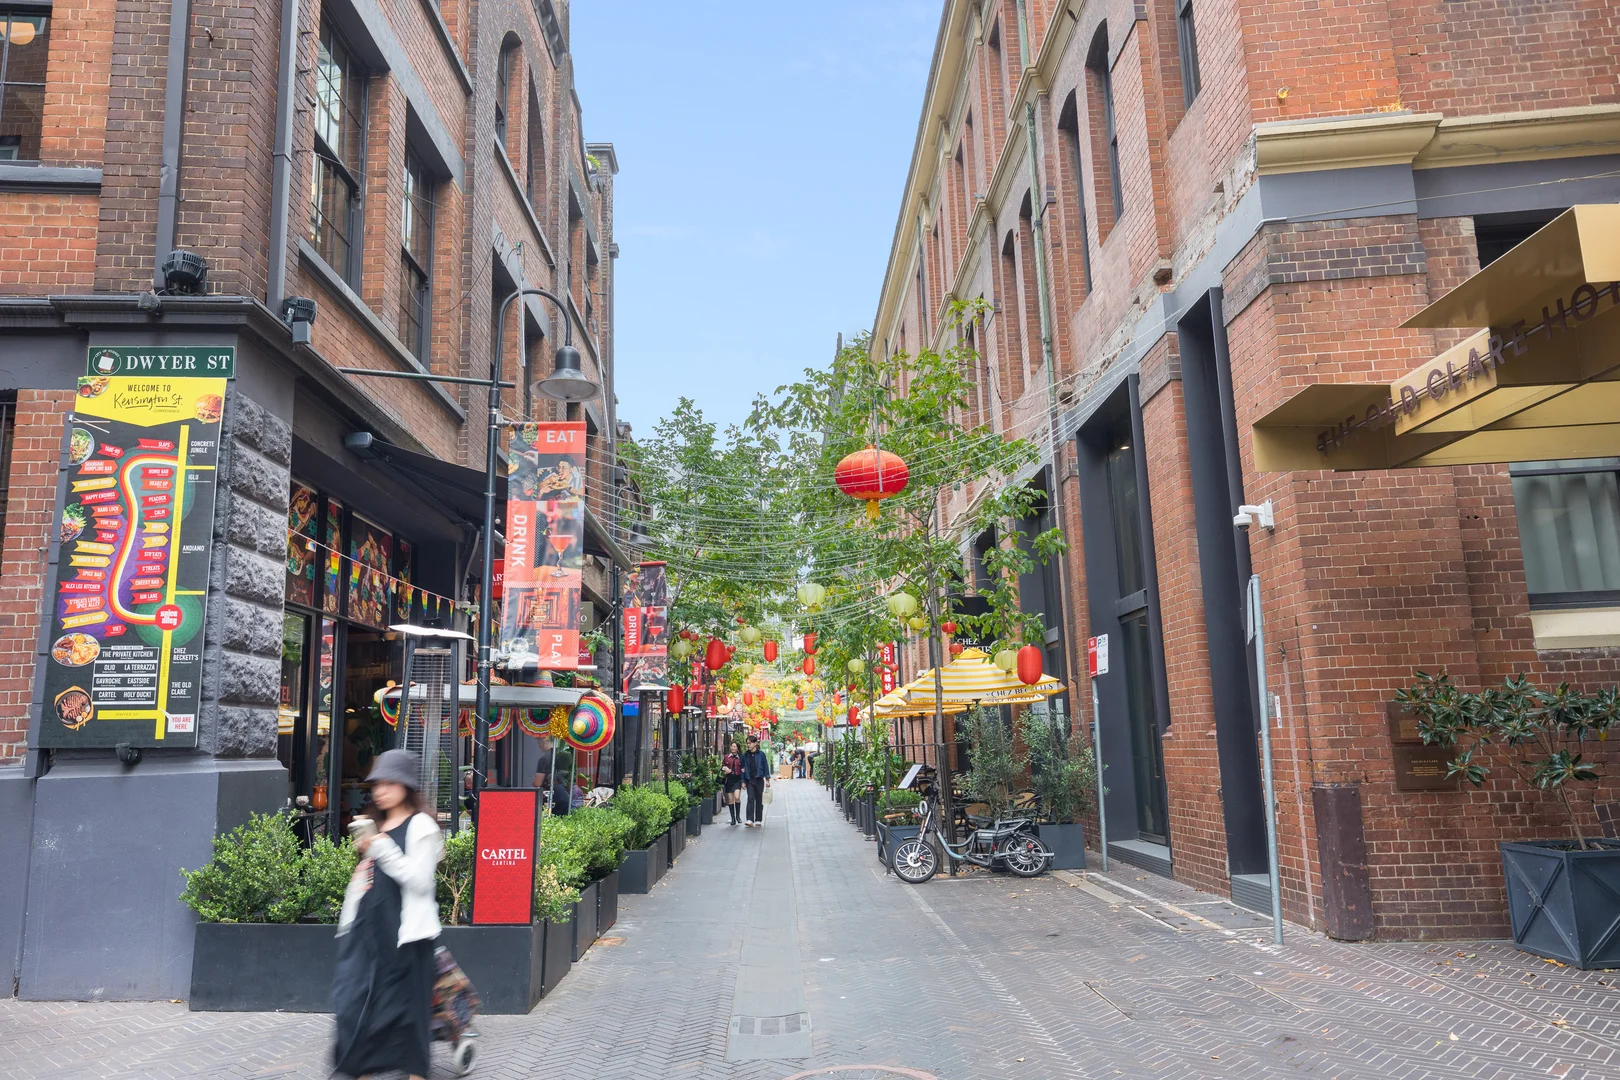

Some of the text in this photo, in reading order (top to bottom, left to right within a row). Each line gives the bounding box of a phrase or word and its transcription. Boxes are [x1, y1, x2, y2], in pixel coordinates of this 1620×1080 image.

[126, 355, 230, 370] DWYER ST
[1366, 384, 1416, 432] OLD
[1426, 319, 1528, 400] CLARE
[114, 393, 168, 410] Kensington
[546, 430, 576, 443] EAT
[512, 514, 527, 567] DRINK
[160, 609, 178, 618] spice
[162, 616, 178, 626] alley
[628, 615, 637, 646] DRINK
[551, 634, 562, 667] PLAY
[481, 849, 527, 860] CARTEL
